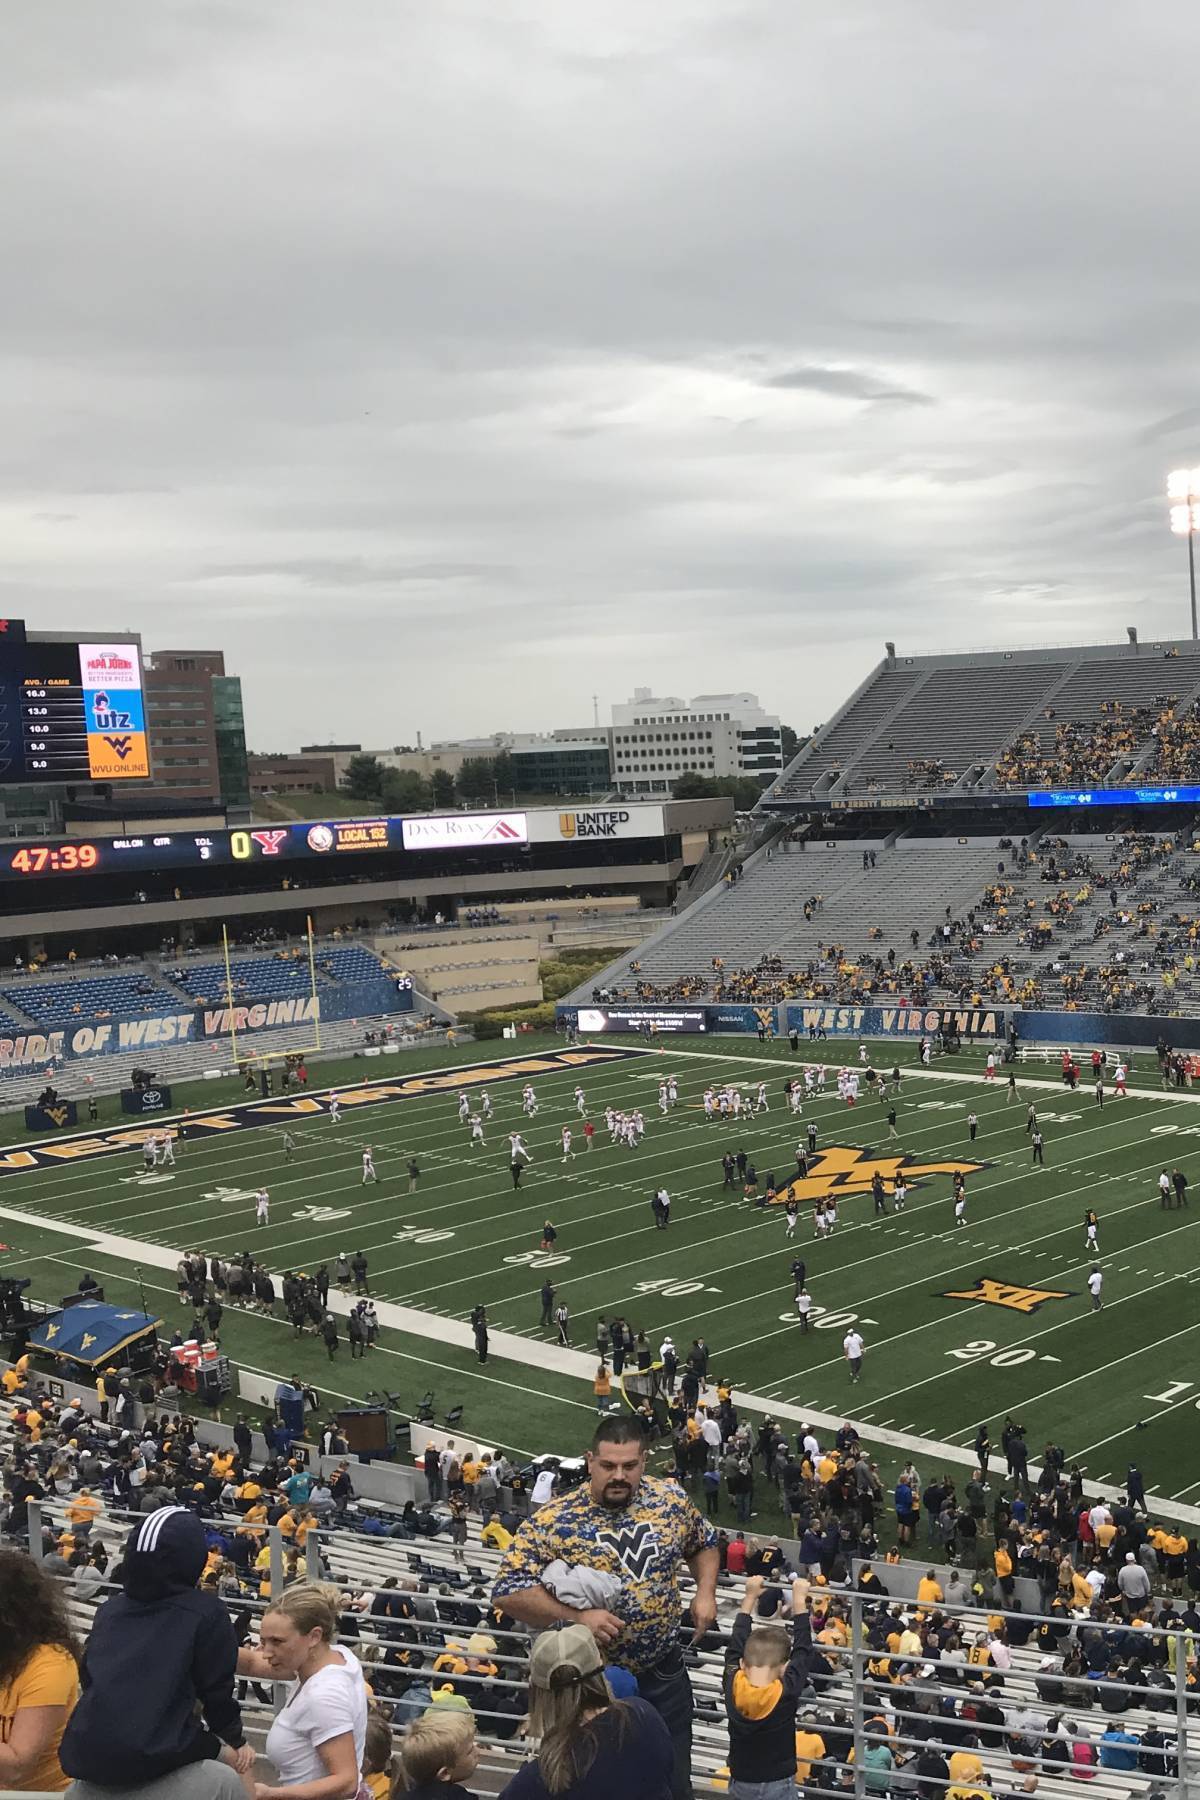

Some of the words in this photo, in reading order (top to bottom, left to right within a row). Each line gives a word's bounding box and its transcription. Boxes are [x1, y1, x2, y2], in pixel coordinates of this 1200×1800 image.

[91, 765, 112, 773] WVU
[113, 764, 146, 772] ONLINE
[576, 811, 629, 825] UNITED
[338, 829, 369, 842] LOCAL
[369, 828, 386, 839] 152
[577, 824, 617, 836] BANK
[11, 845, 97, 872] 47:39
[200, 847, 210, 859] 3
[398, 978, 412, 990] 25
[72, 1024, 113, 1053] OF
[119, 1013, 195, 1047] WEST
[203, 996, 321, 1035] VIRGINIA
[803, 1009, 864, 1029] WEST
[503, 1250, 572, 1268] 50
[632, 1277, 706, 1296] 40
[944, 1340, 1037, 1367] 20
